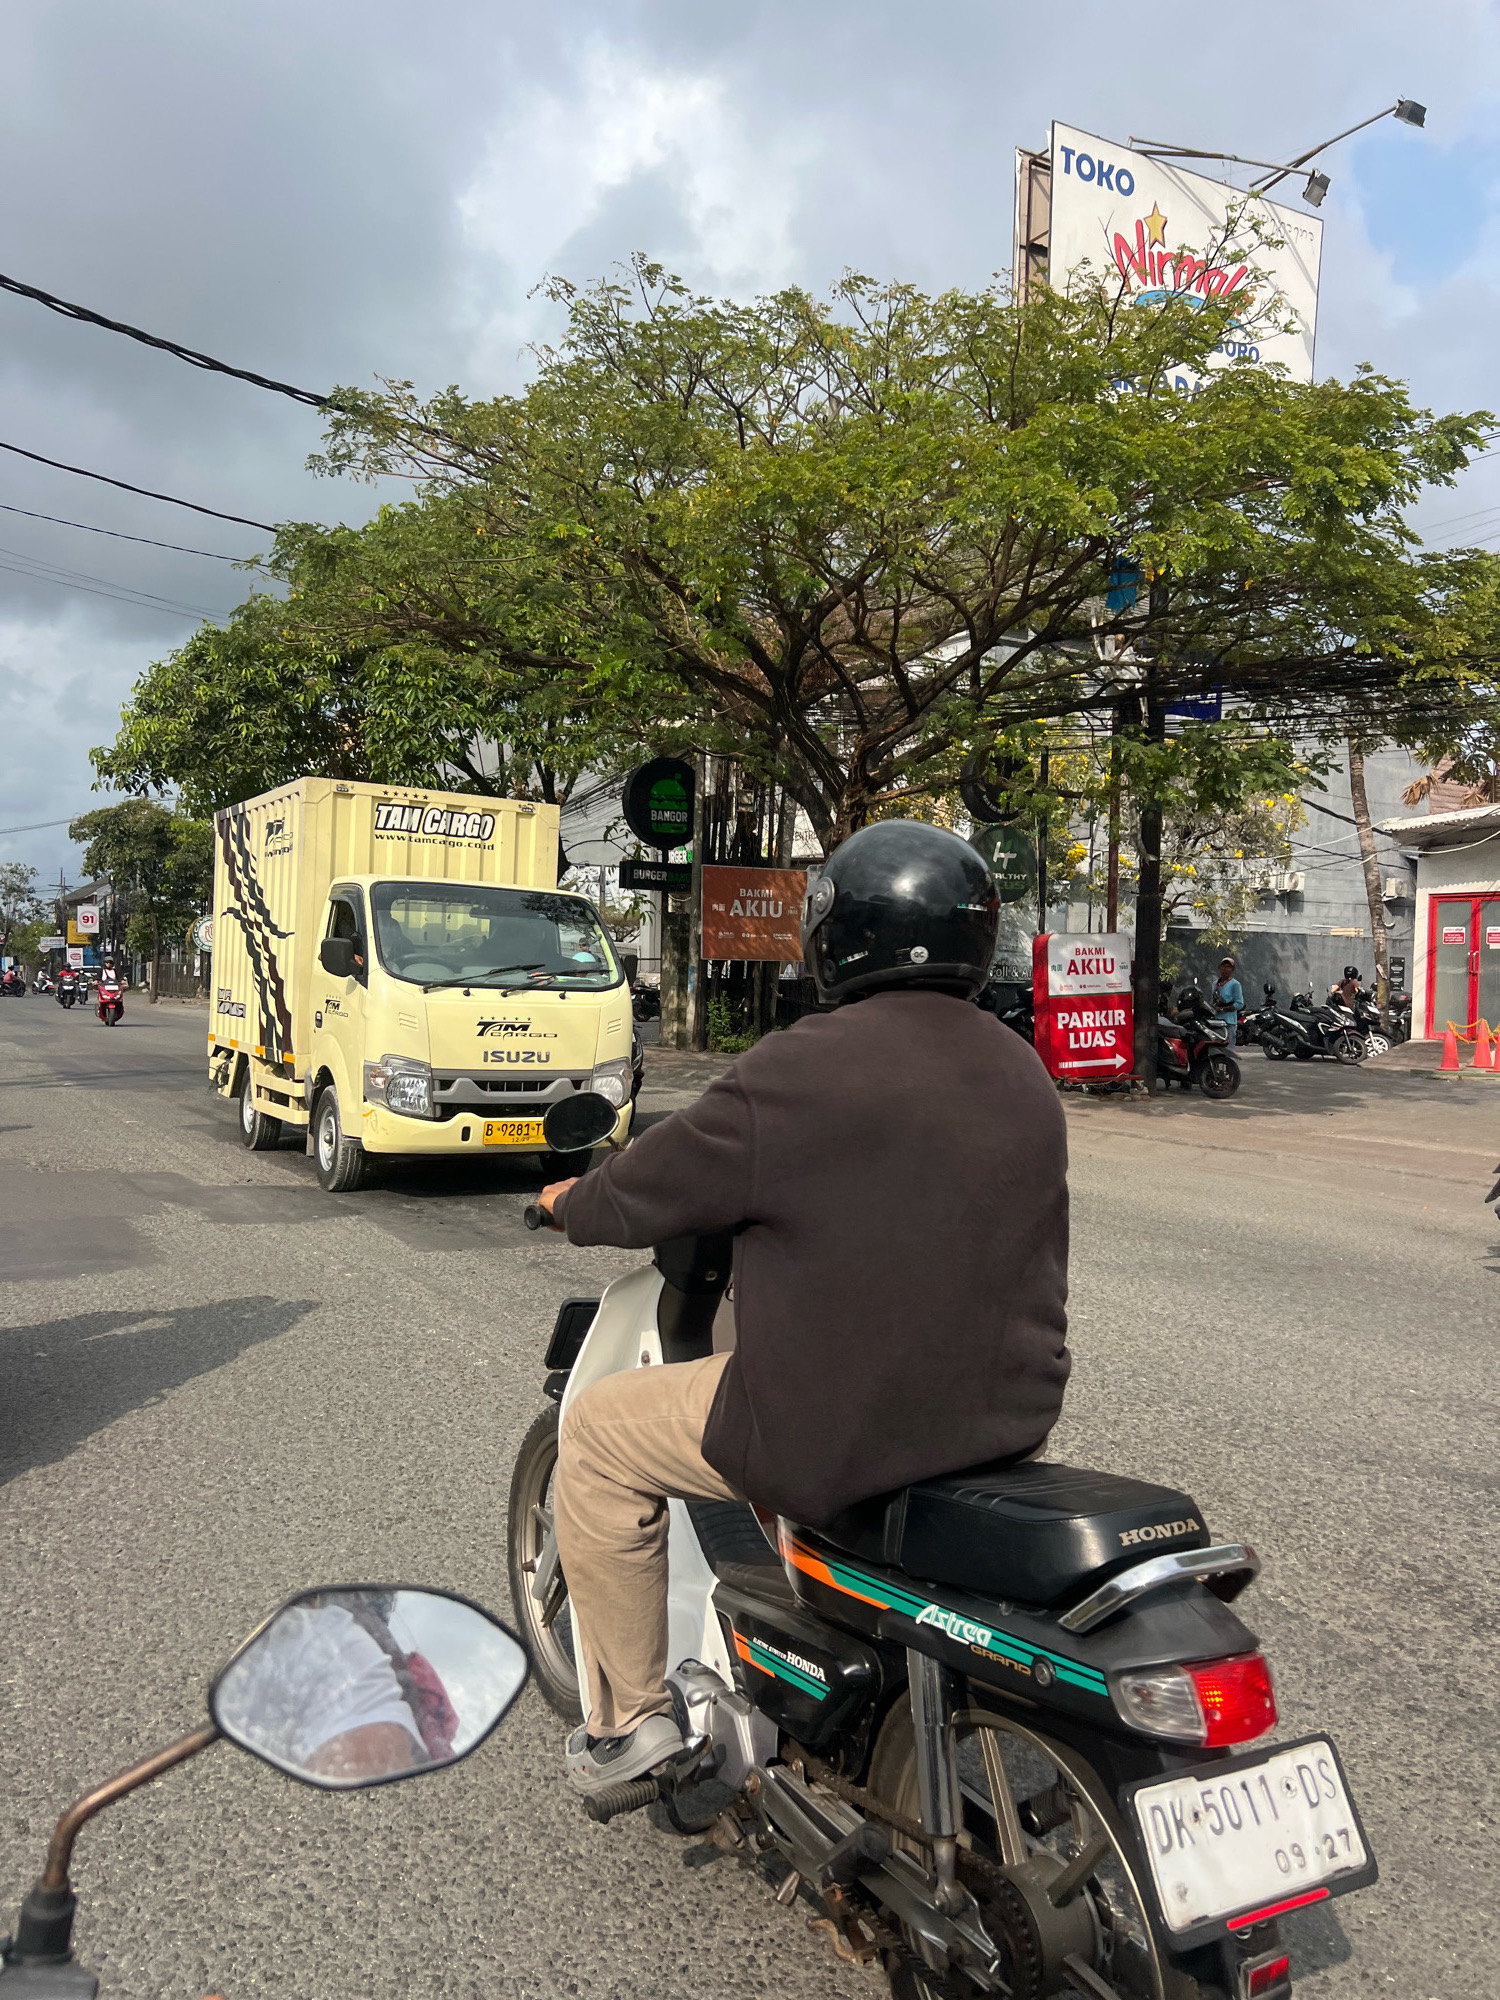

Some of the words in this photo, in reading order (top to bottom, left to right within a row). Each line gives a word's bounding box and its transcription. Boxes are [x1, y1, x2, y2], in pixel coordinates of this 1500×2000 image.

[1060, 145, 1135, 197] TOKO
[375, 803, 424, 833] TAM
[423, 808, 495, 841] CARGO
[651, 810, 688, 822] BANGOR
[375, 834, 494, 851] www.tamcargo.co.id
[633, 869, 667, 881] BURGER
[740, 888, 773, 898] BAKMI
[729, 899, 783, 918] AKIU
[82, 915, 94, 923] 91
[1075, 947, 1105, 956] BAKMI
[1067, 958, 1115, 975] AKIU
[1057, 1009, 1126, 1029] PARKIR
[476, 1021, 532, 1036] TAM
[490, 1032, 558, 1040] CARGO
[1069, 1030, 1116, 1049] LUAS
[483, 1051, 550, 1063] ISUZU
[485, 1123, 493, 1136] B
[501, 1123, 530, 1136] 9281
[536, 1123, 545, 1136] T
[1119, 1517, 1200, 1547] HONDA
[915, 1603, 993, 1647] Astrea
[786, 1651, 826, 1682] HONDA
[970, 1643, 1031, 1677] GRAND
[1150, 1800, 1196, 1856] DK
[1200, 1773, 1280, 1837] 5011
[1296, 1757, 1337, 1809] DS
